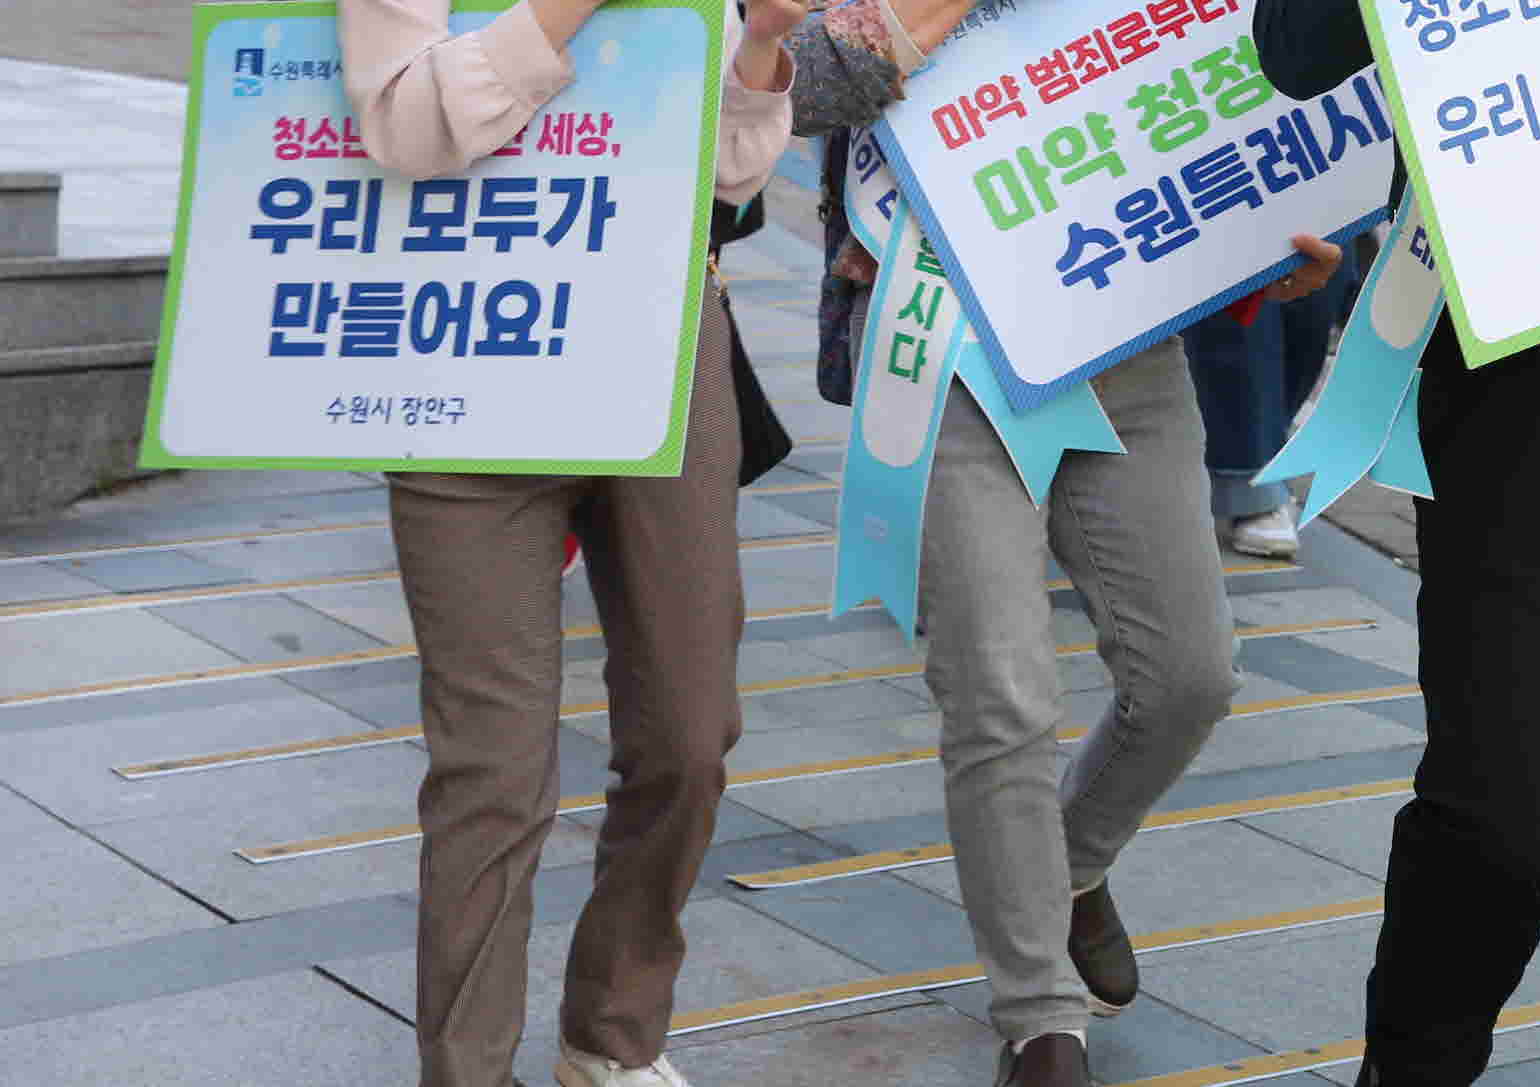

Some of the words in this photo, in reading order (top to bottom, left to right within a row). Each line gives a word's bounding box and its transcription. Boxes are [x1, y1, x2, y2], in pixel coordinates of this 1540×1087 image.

[536, 112, 622, 158] 세상,
[931, 74, 1027, 150] 마약
[973, 111, 1128, 232] 마약
[1125, 35, 1274, 153] 청정
[250, 178, 383, 254] 우리
[402, 174, 617, 254] 모두가
[268, 280, 571, 358] 만들어요!
[325, 396, 392, 425] 수원시
[402, 397, 467, 425] 장안구
